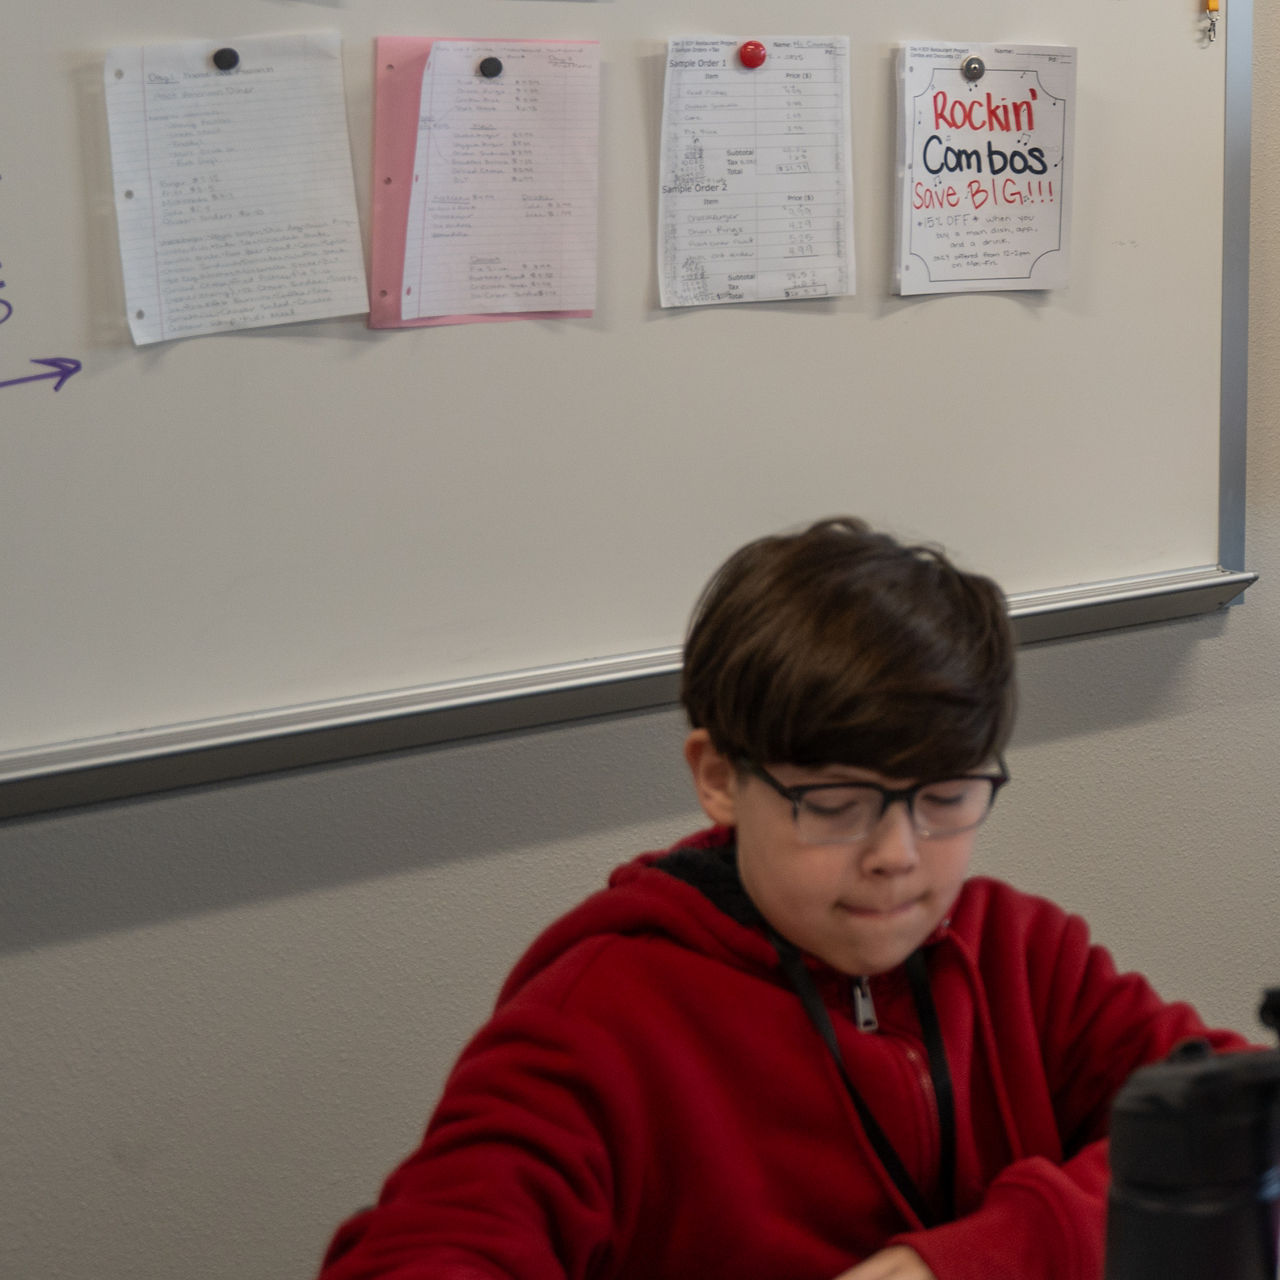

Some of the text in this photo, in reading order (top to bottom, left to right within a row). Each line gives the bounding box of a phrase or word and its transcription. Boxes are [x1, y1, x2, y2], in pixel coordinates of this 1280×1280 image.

[669, 59, 695, 68] Sample
[923, 135, 1047, 175] Combos
[913, 182, 960, 210] Save
